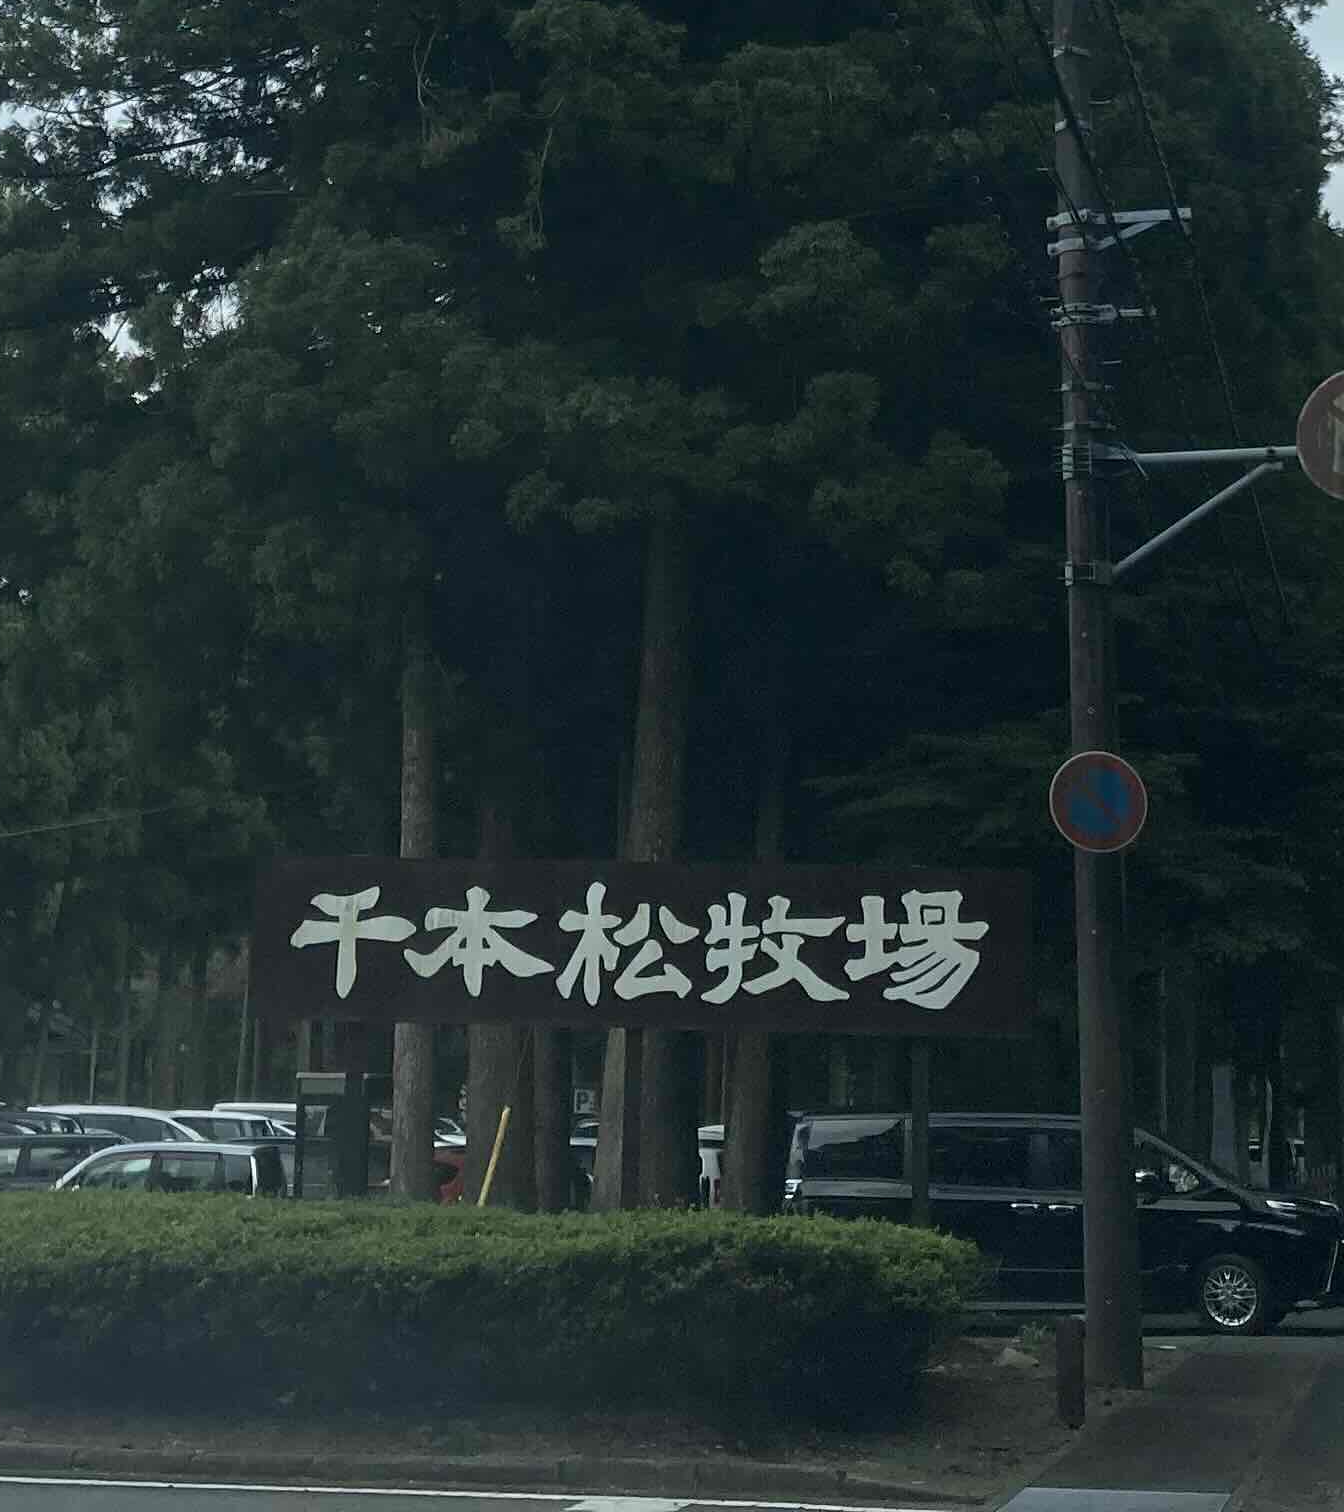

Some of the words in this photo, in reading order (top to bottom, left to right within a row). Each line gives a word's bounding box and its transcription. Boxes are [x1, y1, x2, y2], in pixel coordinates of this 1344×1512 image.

[289, 881, 990, 1010] 千本松牧場
